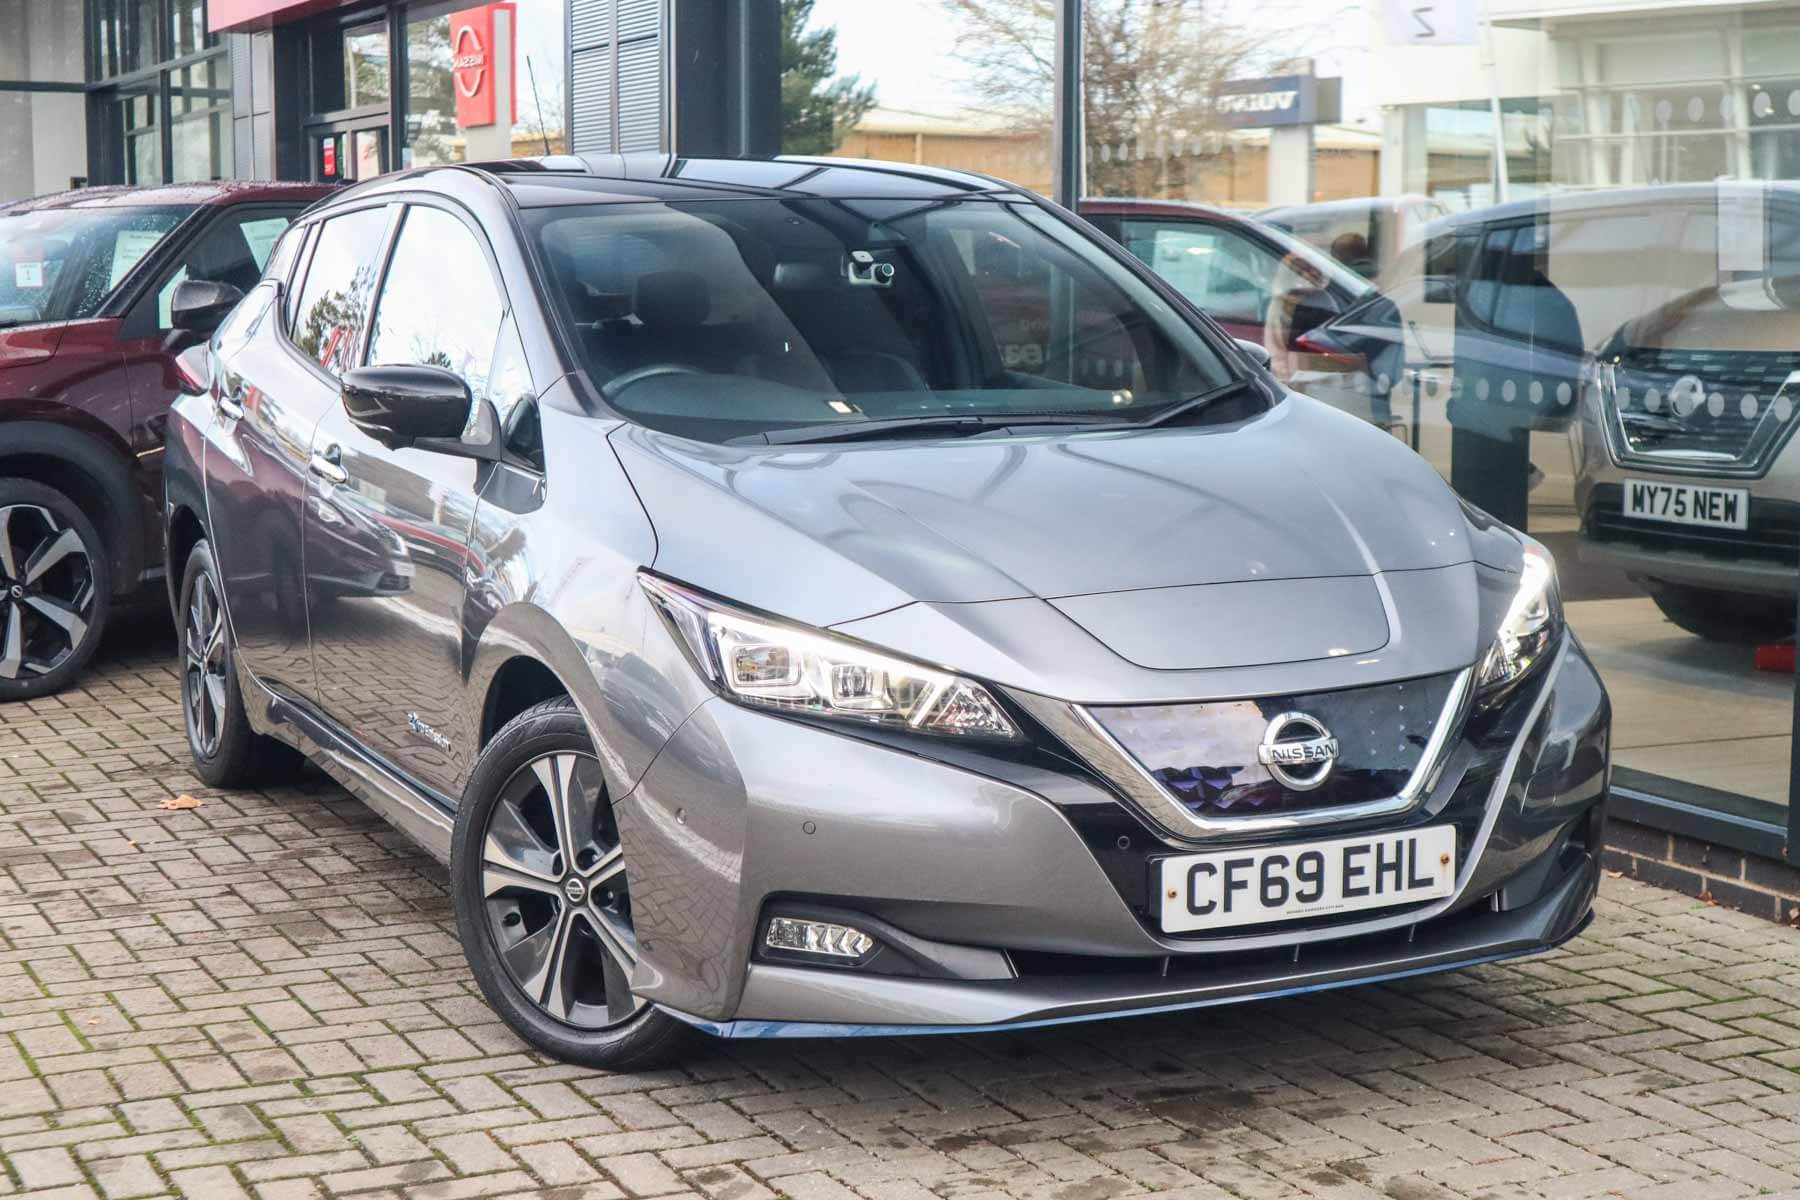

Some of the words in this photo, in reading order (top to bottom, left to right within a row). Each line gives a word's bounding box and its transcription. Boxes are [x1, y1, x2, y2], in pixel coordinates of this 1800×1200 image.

[1632, 484, 1687, 517] MY75
[1693, 490, 1738, 522] NEW
[1272, 743, 1335, 760] NISSAN
[1187, 851, 1324, 915] CF69
[1342, 838, 1434, 898] EHL
